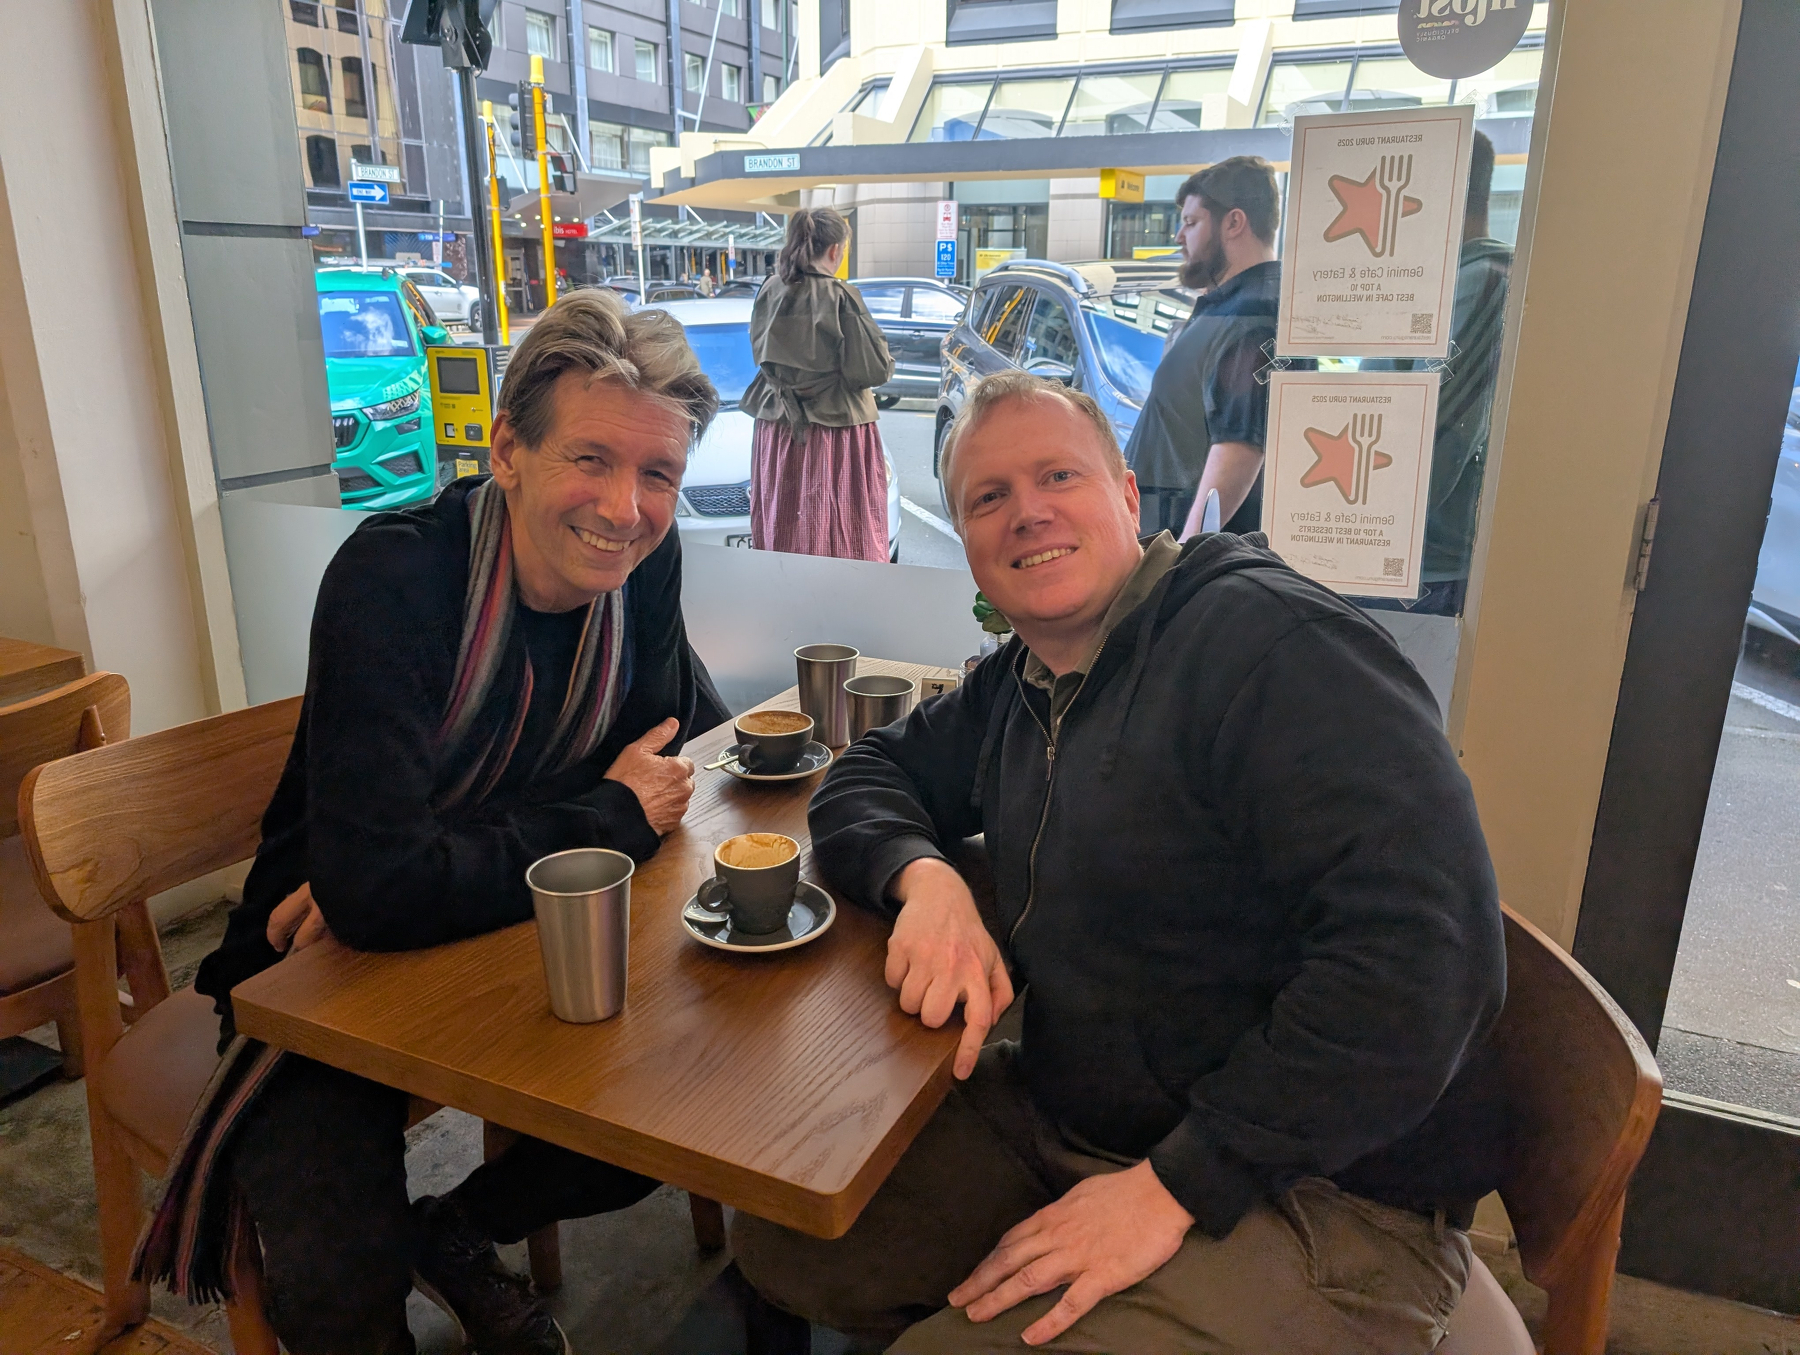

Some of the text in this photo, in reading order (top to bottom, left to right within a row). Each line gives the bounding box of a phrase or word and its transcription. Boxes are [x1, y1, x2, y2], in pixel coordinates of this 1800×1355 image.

[748, 157, 796, 169] BRANDON ST
[361, 167, 395, 179] BRANDON ST
[553, 226, 565, 234] ibis
